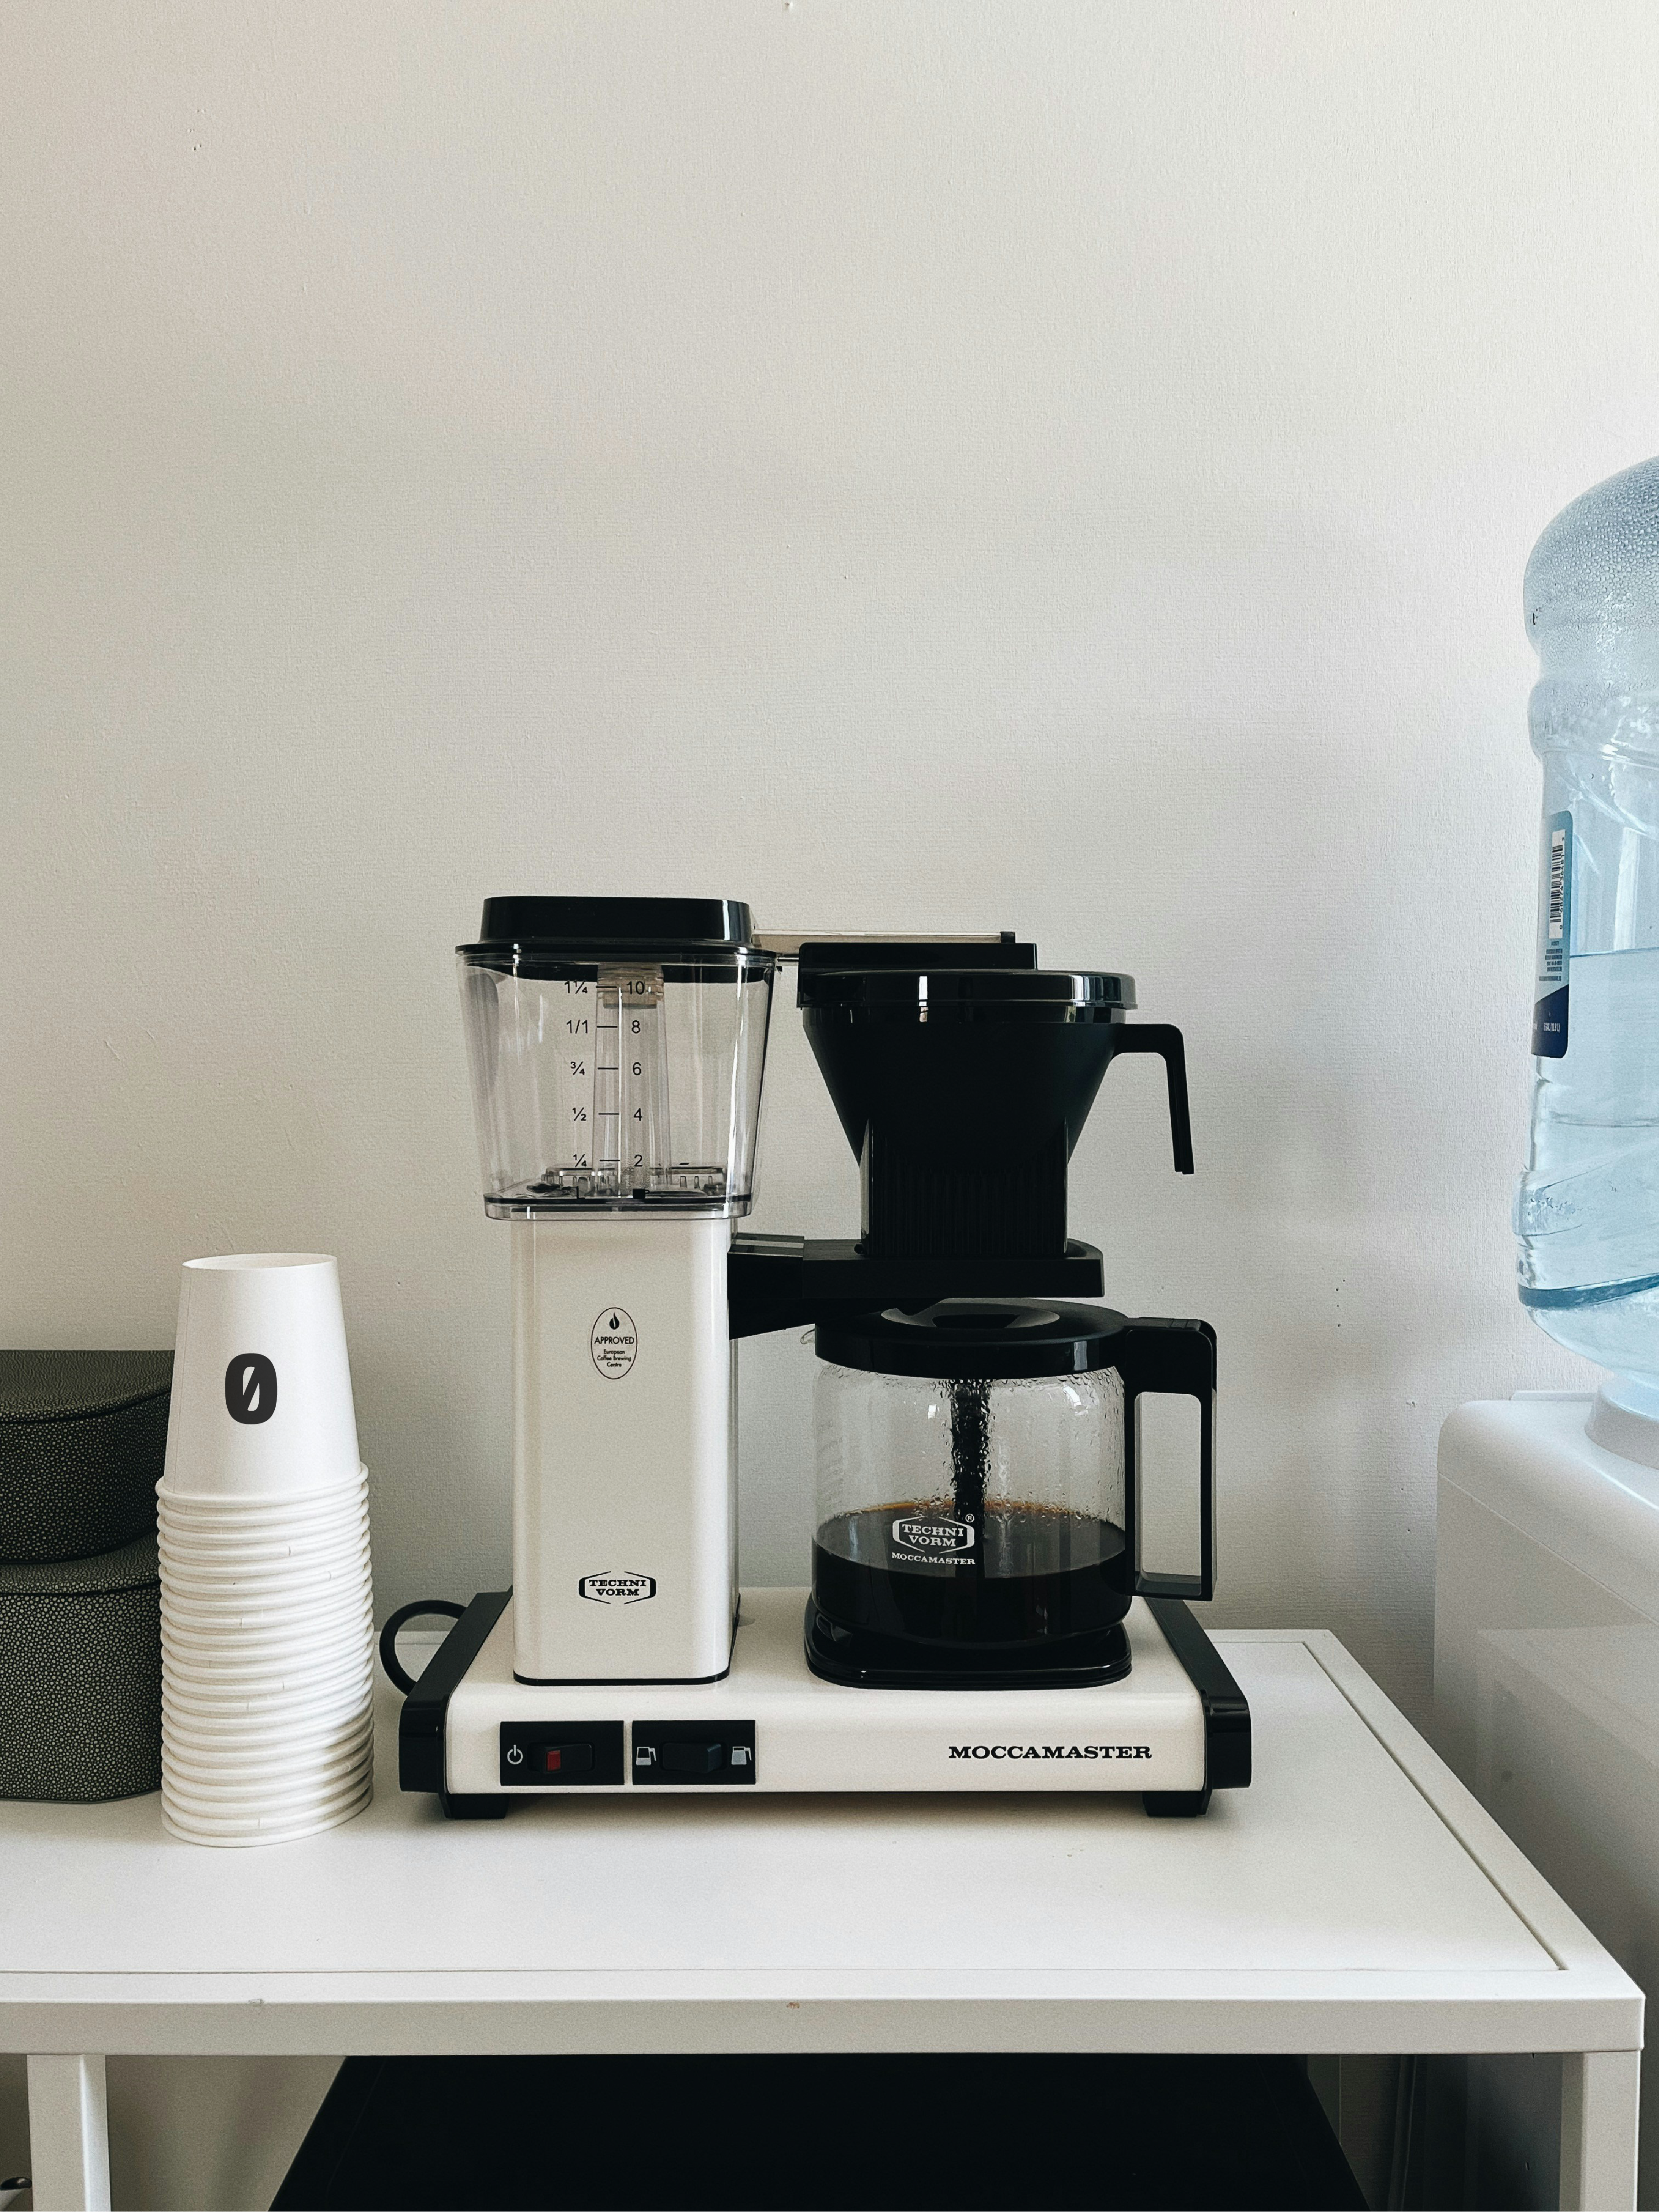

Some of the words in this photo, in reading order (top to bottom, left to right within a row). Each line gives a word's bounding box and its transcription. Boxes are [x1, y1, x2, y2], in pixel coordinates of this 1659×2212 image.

[627, 981, 645, 994] 10
[566, 1020, 588, 1034] 1/1
[631, 1020, 640, 1034] 8
[633, 1062, 642, 1076] 6
[634, 1108, 643, 1121] 4
[634, 1154, 643, 1167] 2
[594, 1336, 635, 1344] APPROVED
[902, 1524, 964, 1536] TECHNI
[908, 1535, 956, 1547] VORM
[891, 1552, 976, 1565] MOCCAMASTER
[949, 1746, 1152, 1759] MOCCAMASTER
